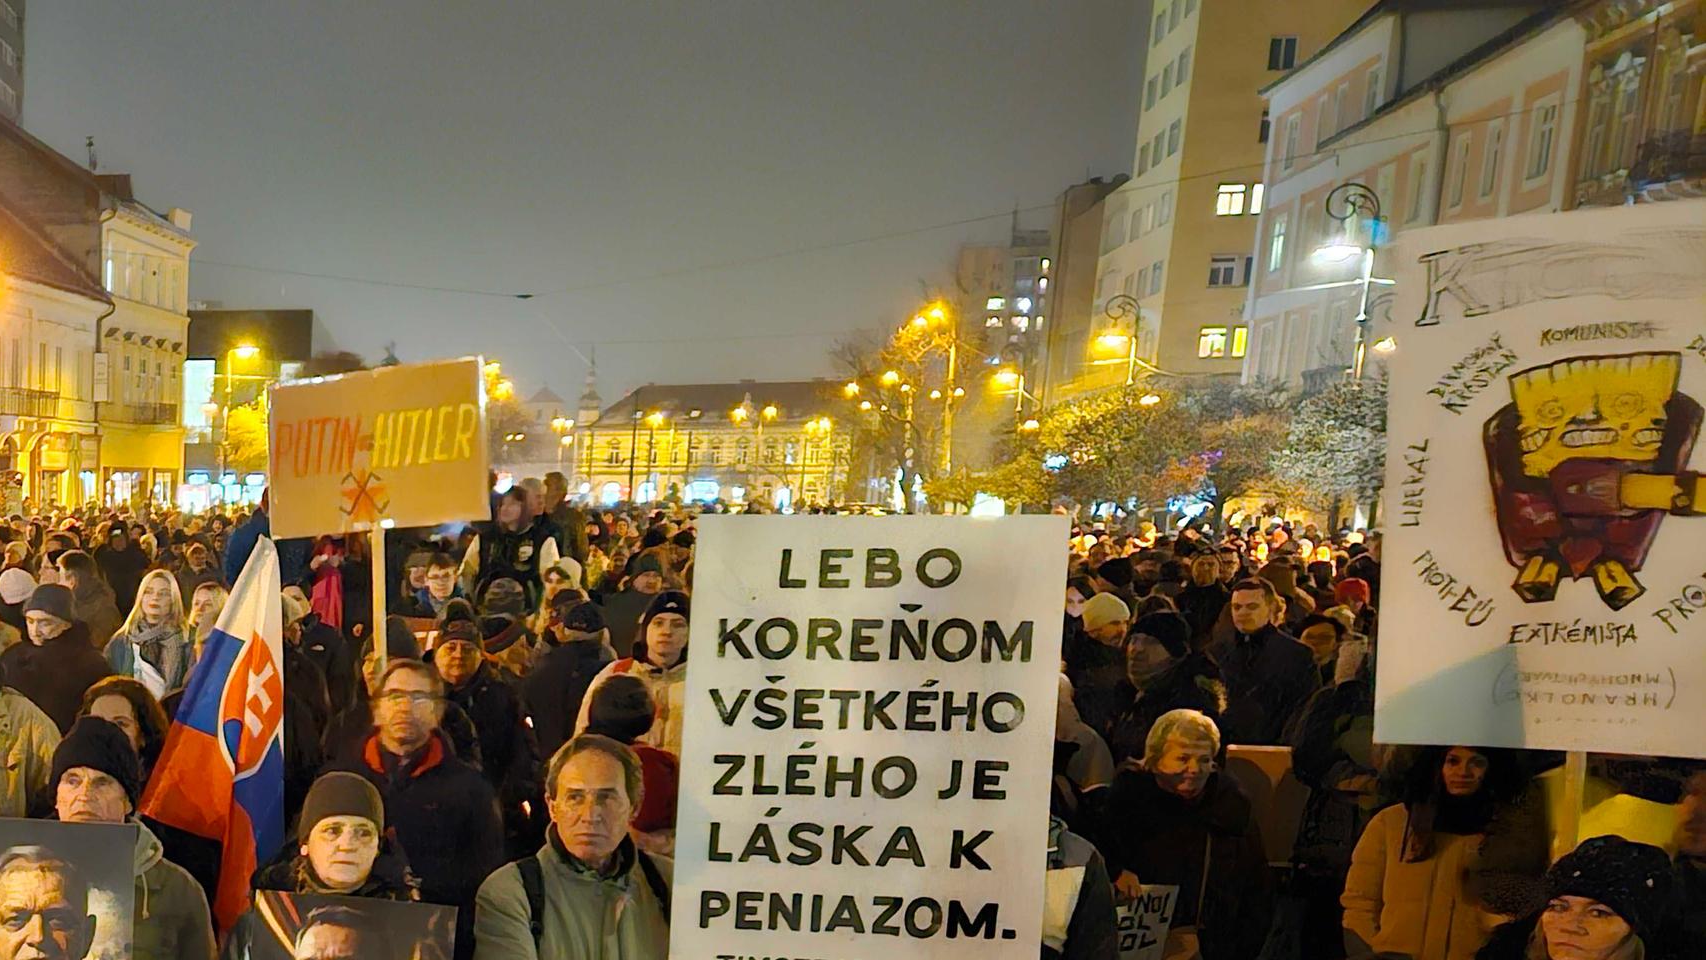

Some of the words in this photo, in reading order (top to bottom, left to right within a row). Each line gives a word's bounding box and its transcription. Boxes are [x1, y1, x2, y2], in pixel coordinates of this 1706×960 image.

[779, 548, 963, 589] LEBO
[716, 603, 1034, 663] KOREŇOM
[708, 675, 1026, 733] VŠETKÉHO
[711, 741, 918, 800] ZLÉHO
[937, 759, 1010, 800] JE
[707, 806, 926, 868] LÁSKA
[949, 828, 995, 871] K
[699, 890, 1017, 940] PENIAZOM.
